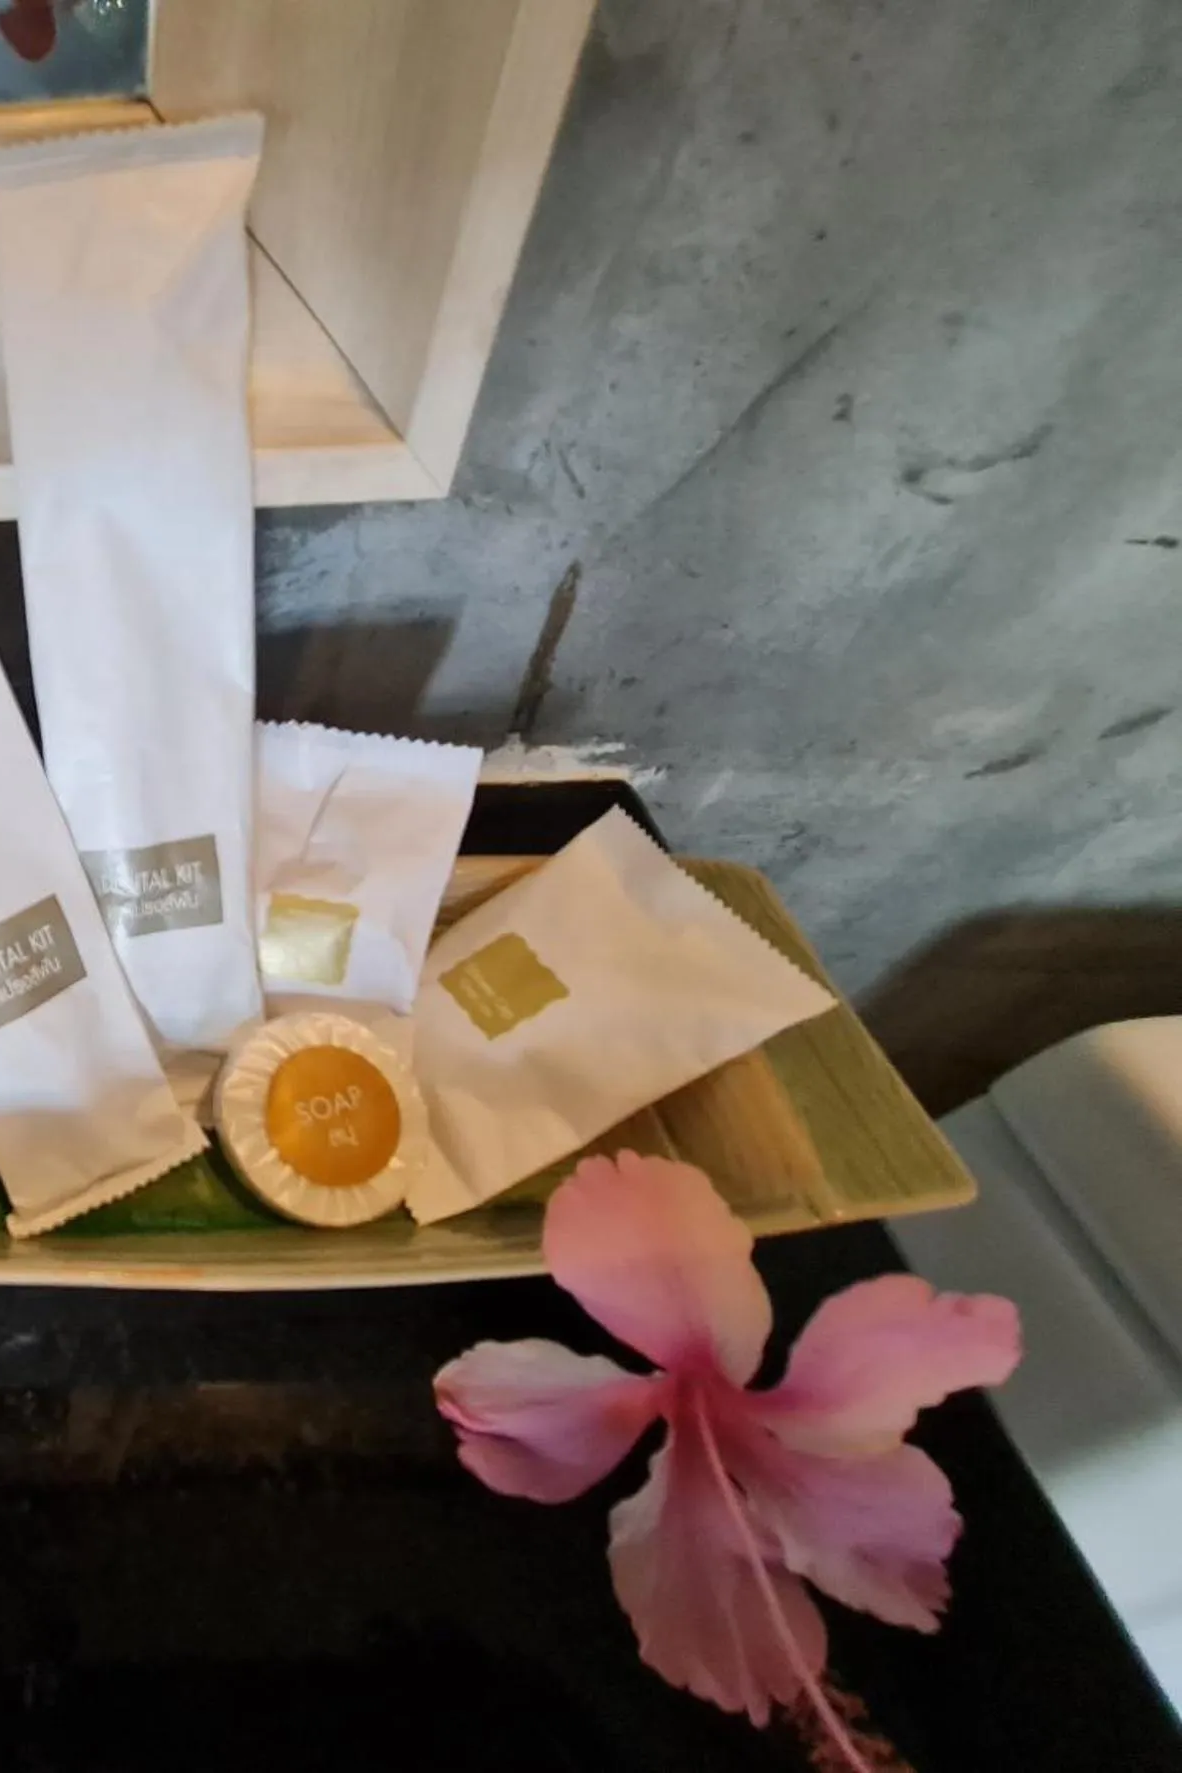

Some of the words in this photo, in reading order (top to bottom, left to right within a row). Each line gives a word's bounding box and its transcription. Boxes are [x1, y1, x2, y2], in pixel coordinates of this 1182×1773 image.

[174, 861, 202, 887] KIT
[28, 924, 56, 953] KIT
[294, 1085, 363, 1127] SOAP
